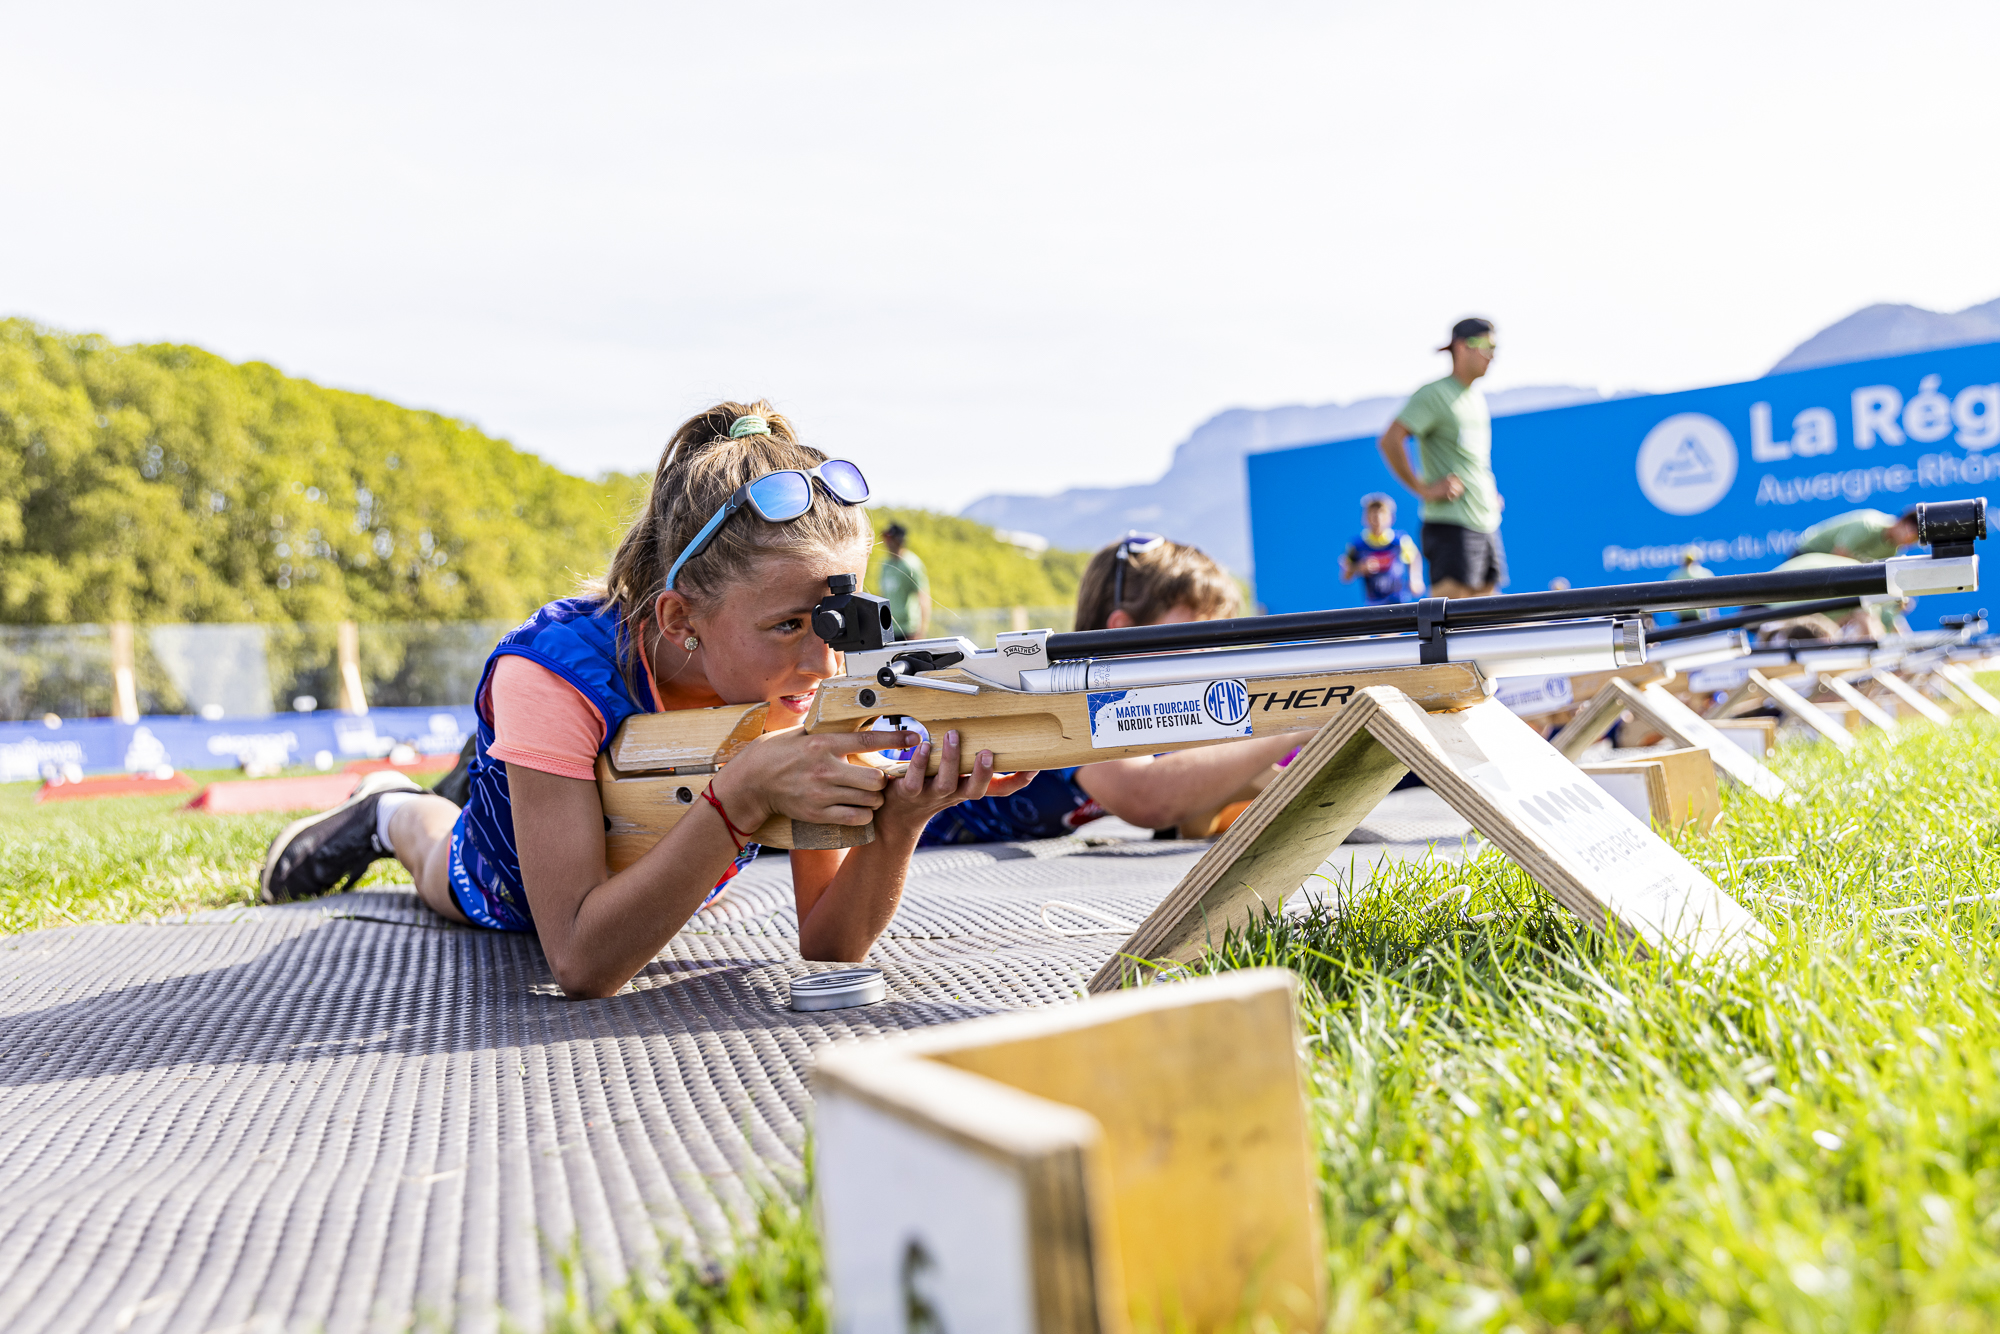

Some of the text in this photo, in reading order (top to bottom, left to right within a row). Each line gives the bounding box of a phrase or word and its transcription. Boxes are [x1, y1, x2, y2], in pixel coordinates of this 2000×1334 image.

[1749, 400, 1838, 463] La
[1008, 646, 1036, 655] WALTHER
[1115, 699, 1201, 719] MARTIN FOURCADE
[1208, 681, 1245, 721] MFNF
[1117, 712, 1203, 731] NORDIC FESTIVAL
[1577, 827, 1647, 873] EXPERIENCE
